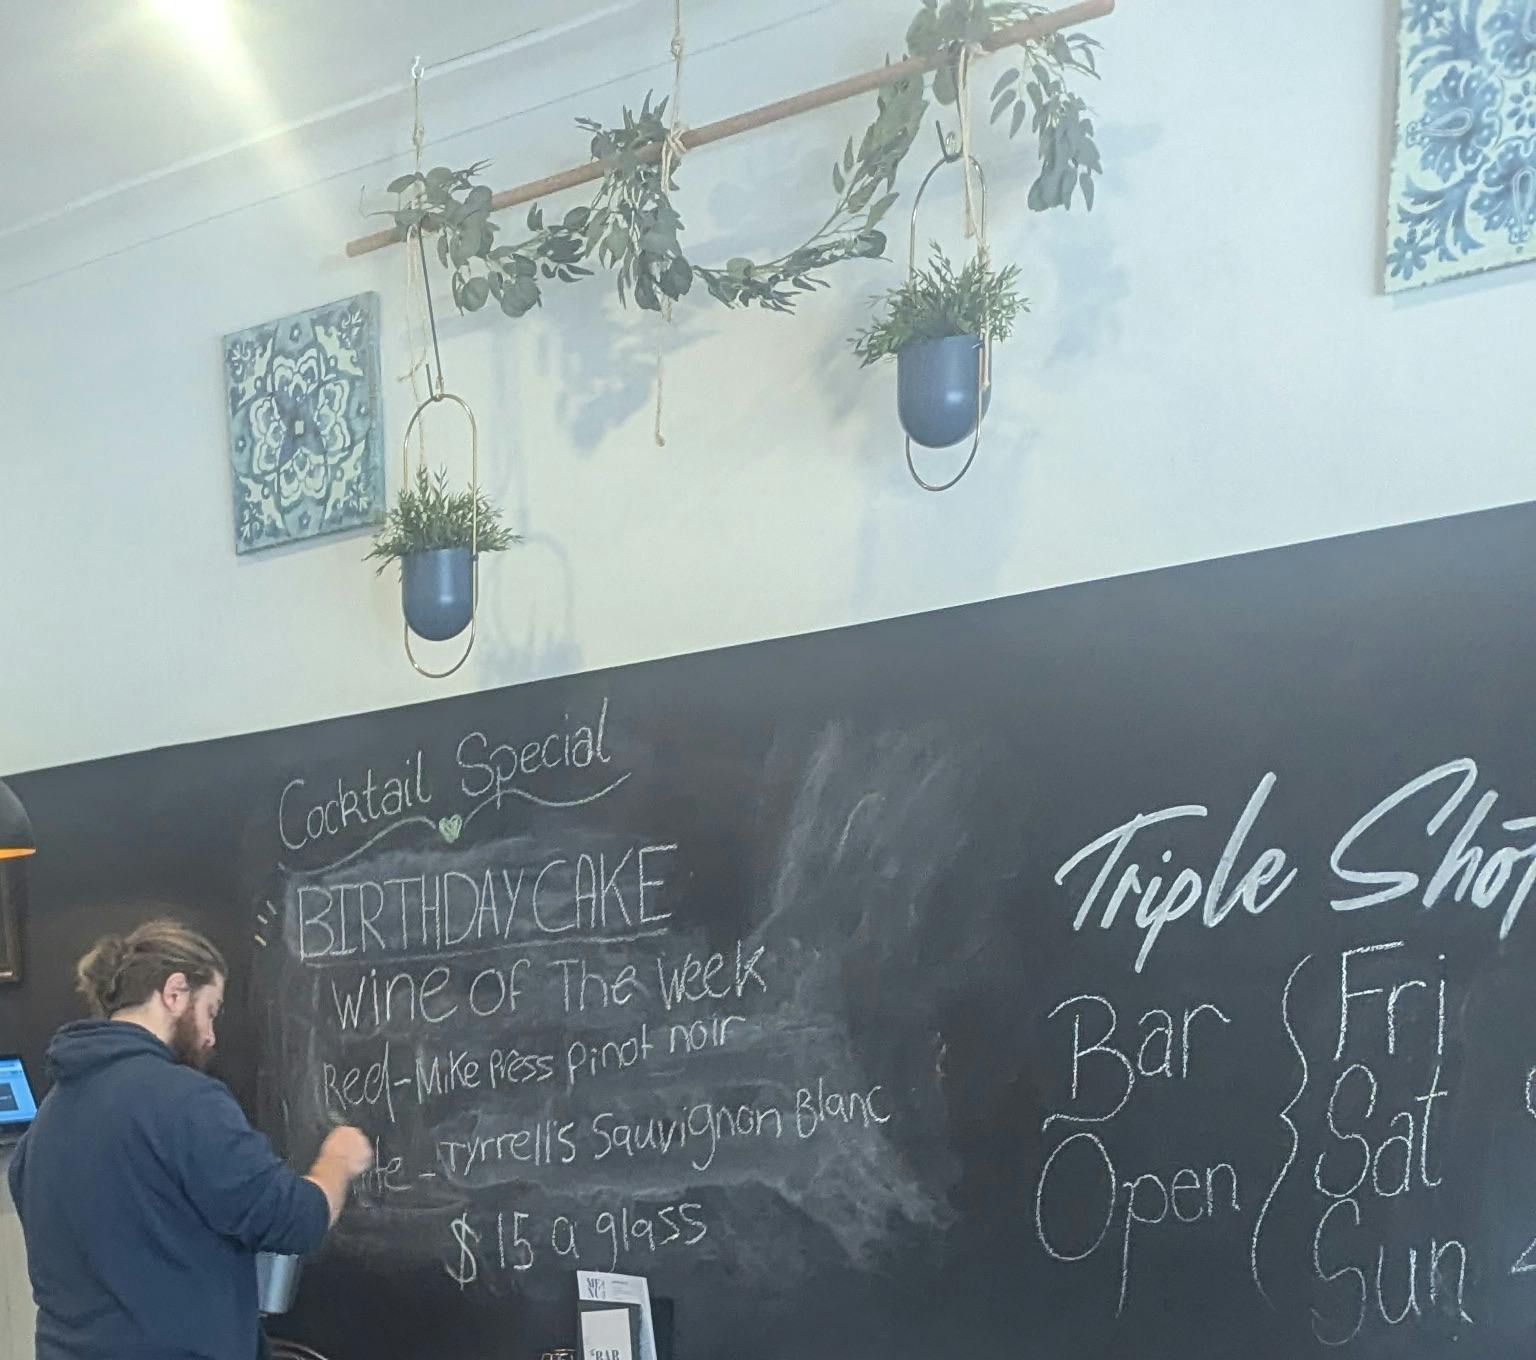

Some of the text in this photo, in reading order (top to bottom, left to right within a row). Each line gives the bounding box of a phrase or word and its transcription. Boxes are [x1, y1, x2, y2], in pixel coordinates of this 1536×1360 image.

[279, 697, 612, 850] Cocktail Special
[297, 844, 679, 962] BIRTHDAY CAKE
[1054, 758, 1536, 974] Triple Shot
[546, 960, 636, 1012] The
[1334, 941, 1447, 1061] Fri
[1042, 994, 1231, 1131] Bar
[353, 1136, 413, 1192] ite
[440, 1119, 576, 1176] Tyrrell's
[592, 1104, 782, 1171] Sauvignon
[796, 1077, 891, 1139] Blanc
[1315, 1063, 1449, 1198] Sat
[552, 1216, 580, 1258] a
[596, 1203, 708, 1272] glass
[1036, 1132, 1241, 1319] Open
[1311, 1198, 1473, 1344] Sun
